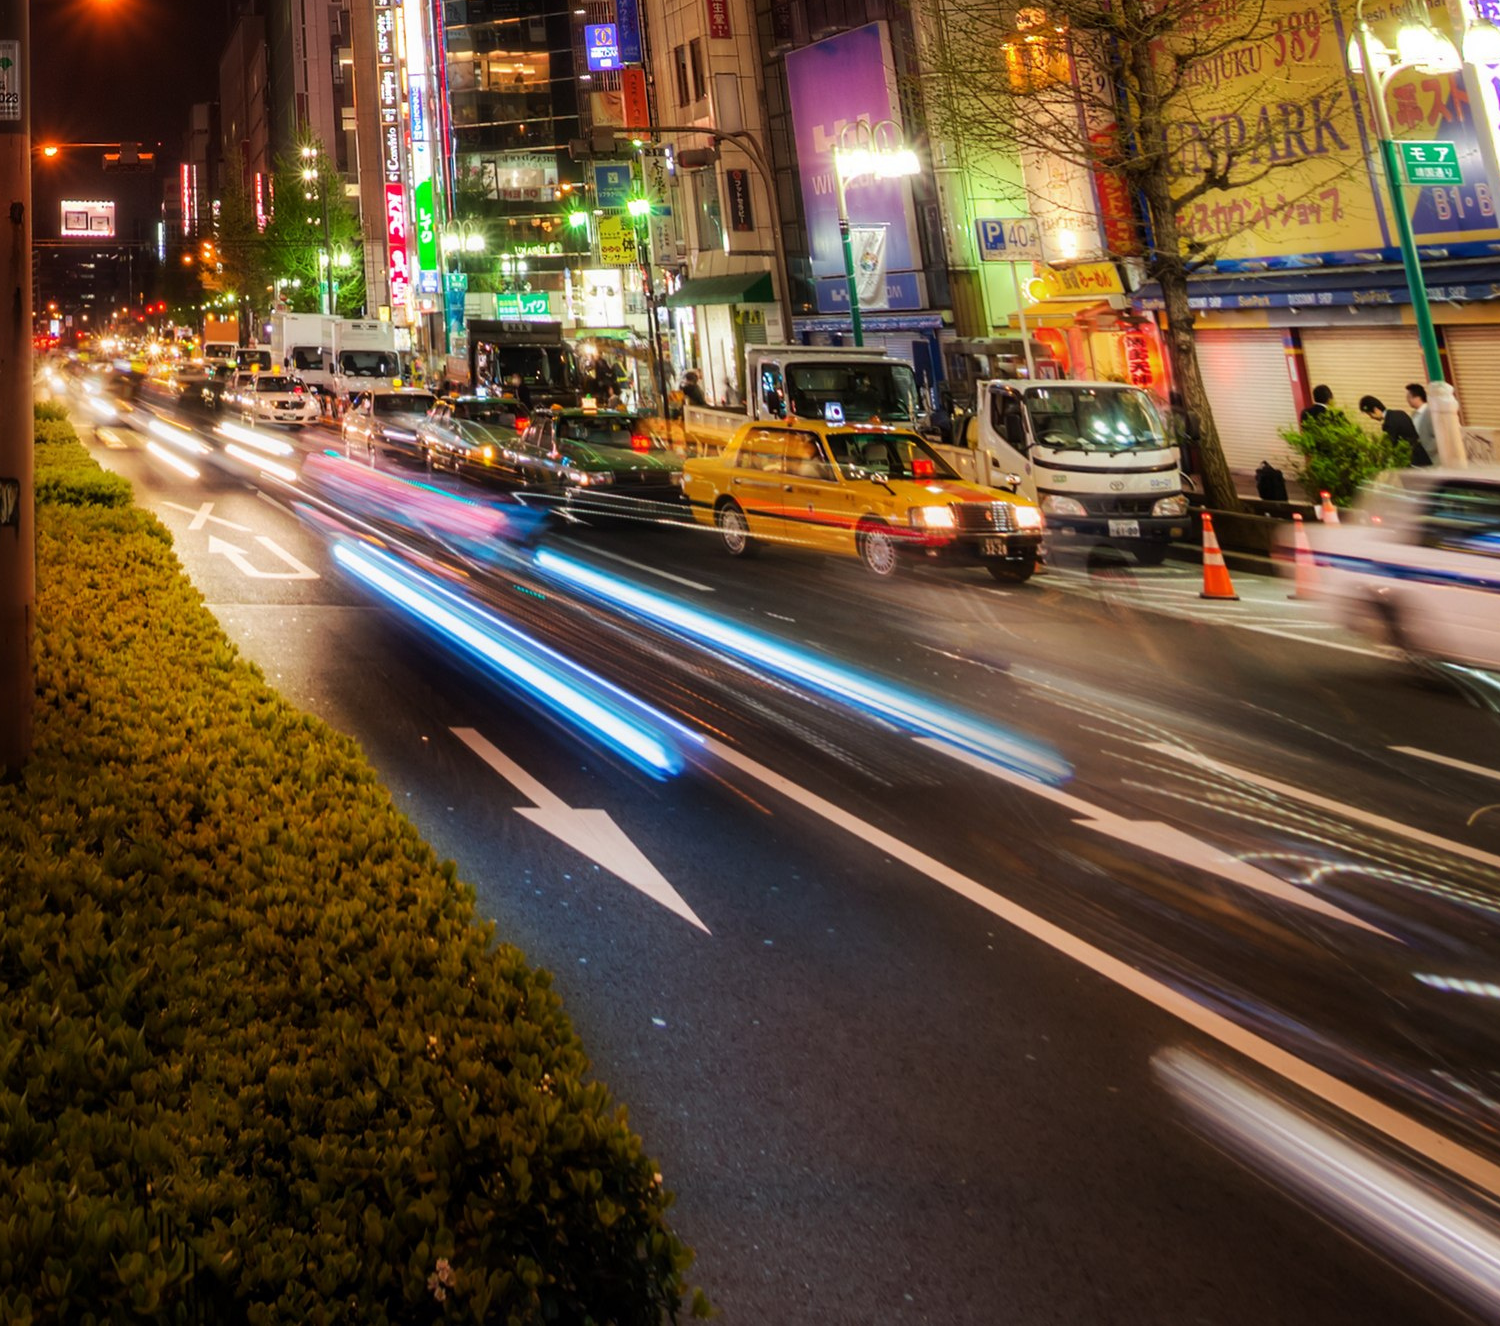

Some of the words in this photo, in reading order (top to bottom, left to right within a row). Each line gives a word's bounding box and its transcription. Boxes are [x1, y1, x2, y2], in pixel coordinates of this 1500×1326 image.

[1409, 146, 1449, 162] モア
[419, 207, 433, 244] レイク
[985, 220, 1000, 241] P
[1317, 292, 1333, 304] SHOP
